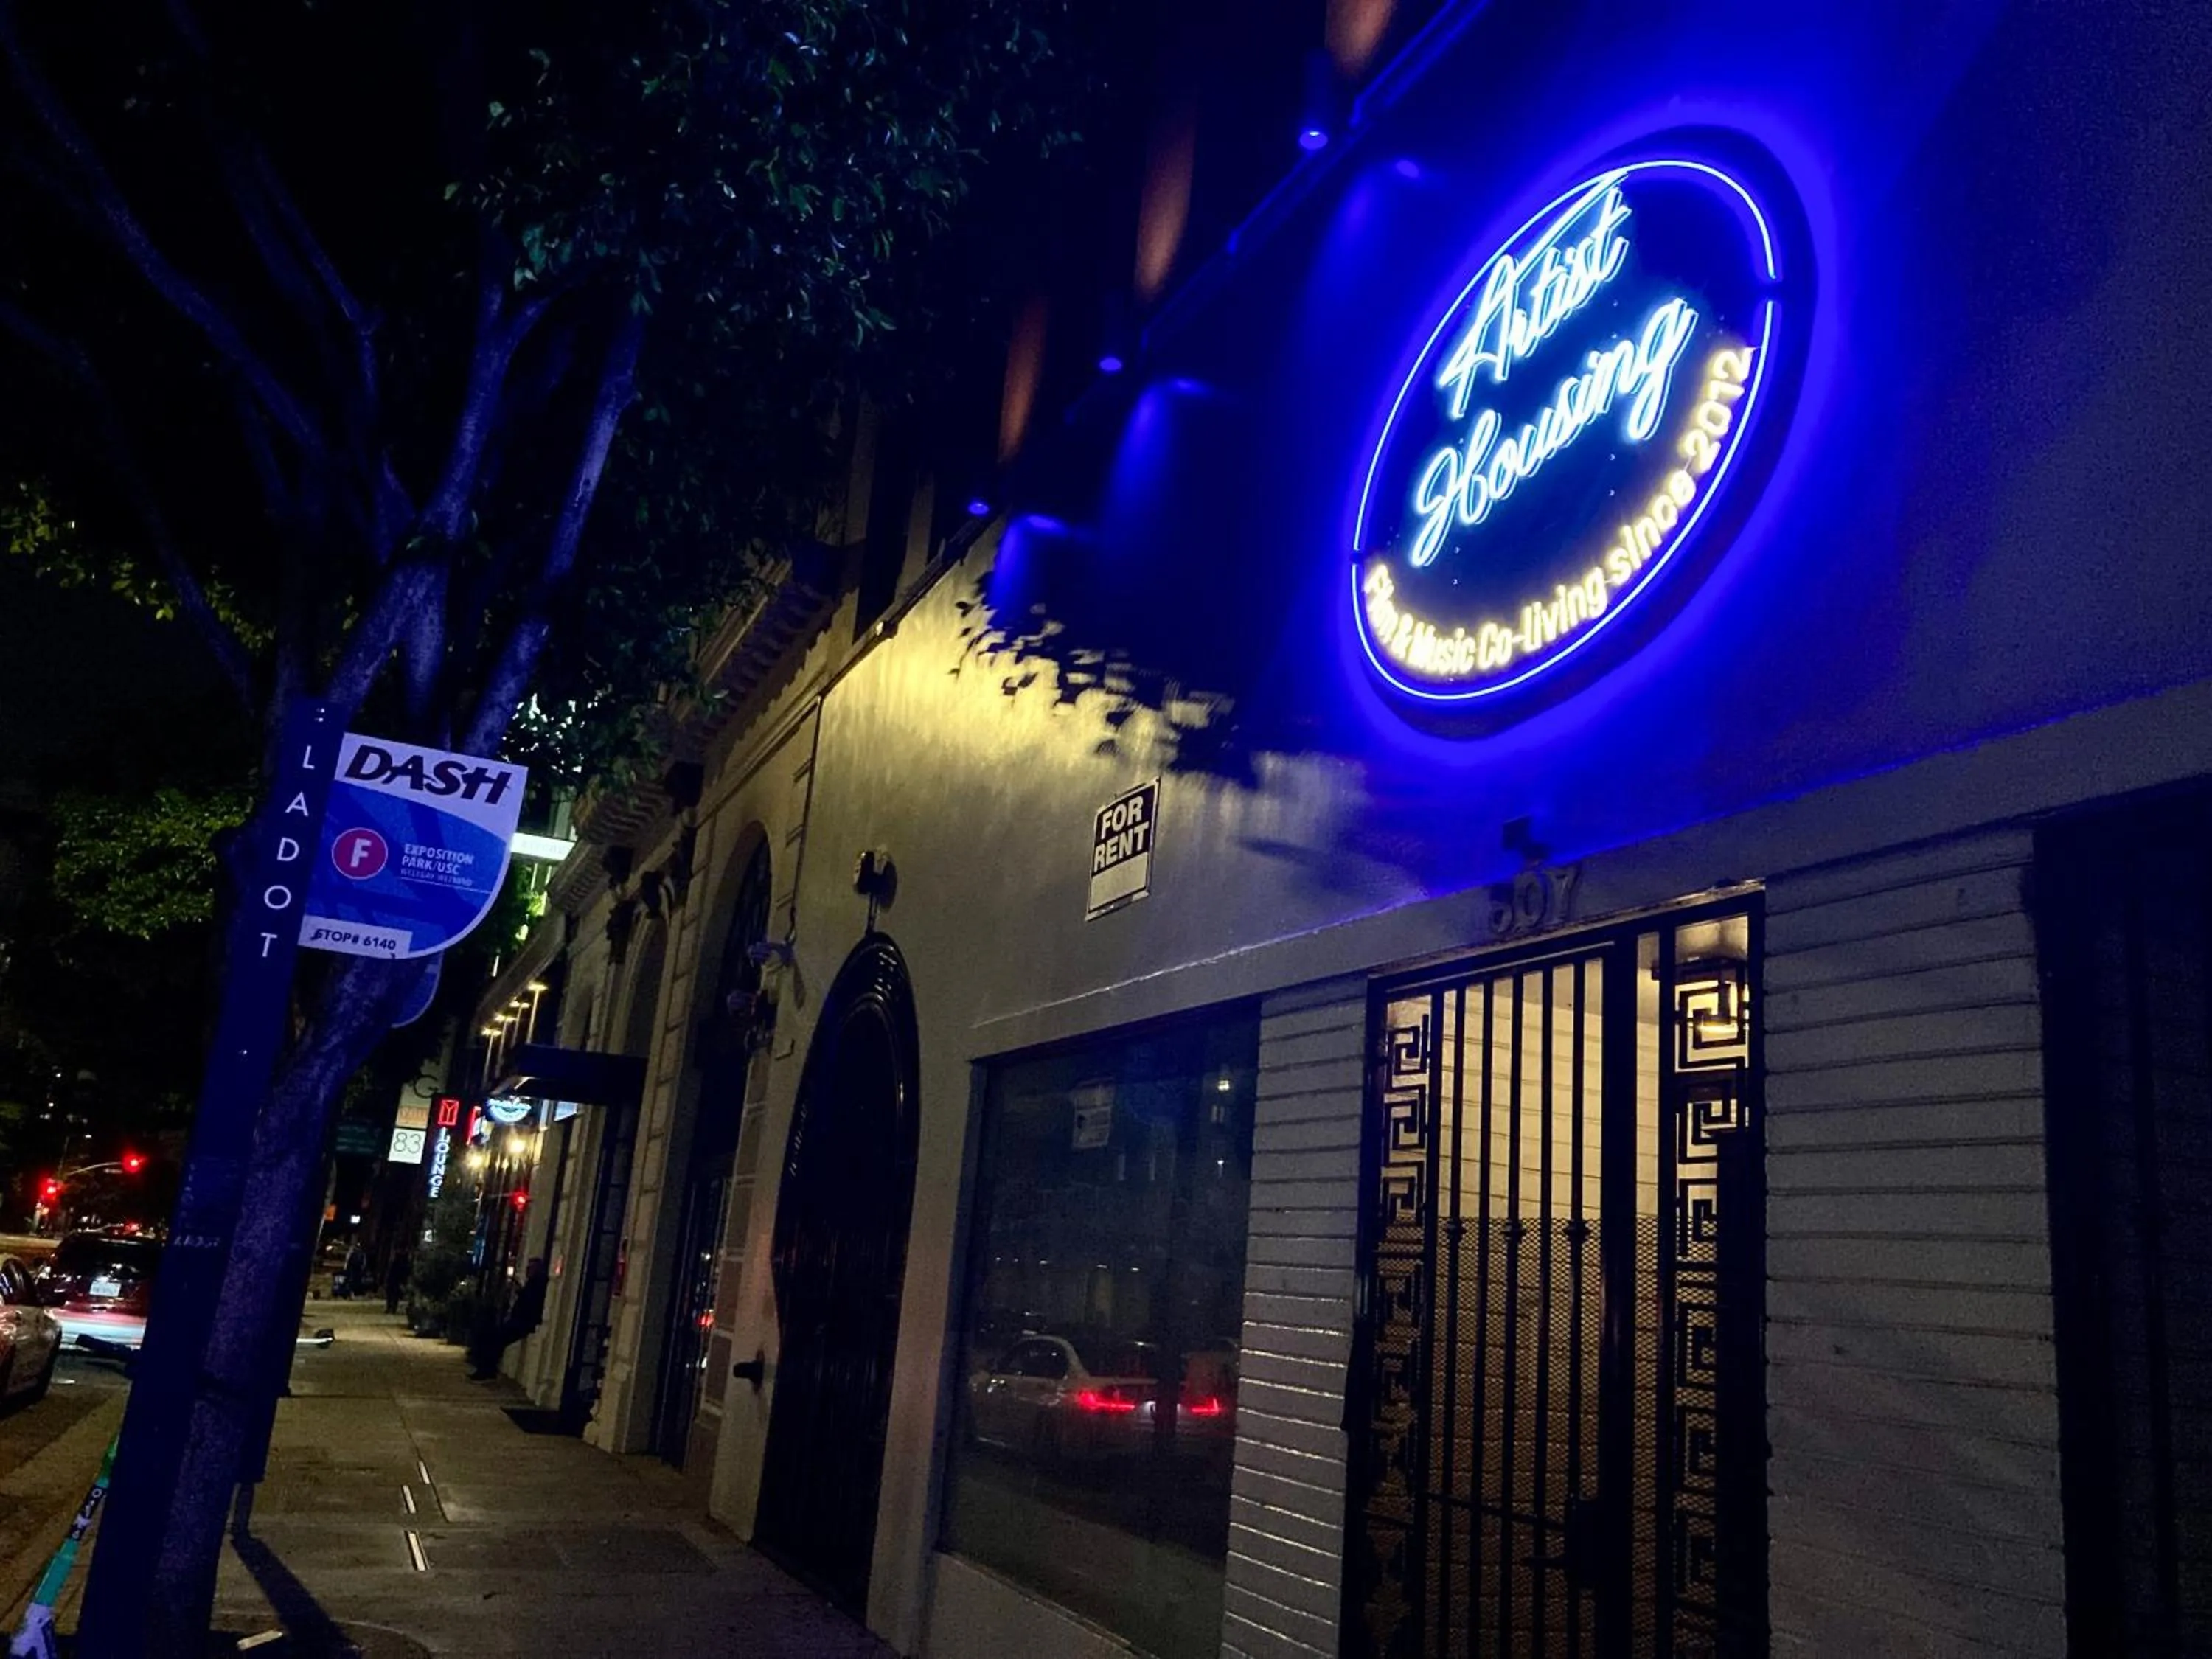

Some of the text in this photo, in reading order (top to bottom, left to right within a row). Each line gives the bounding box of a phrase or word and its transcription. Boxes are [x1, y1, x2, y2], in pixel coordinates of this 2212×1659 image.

[1436, 167, 1632, 419] Artist
[1411, 298, 1699, 567] Housing
[1406, 622, 1475, 675] Music
[1606, 470, 1697, 586] since
[1680, 348, 1753, 473] 2012
[344, 744, 512, 805] DASH
[1100, 796, 1144, 840] FOR
[350, 838, 372, 867] F
[401, 855, 461, 875] PARK/USC
[403, 843, 475, 865] EXPOSITION
[1093, 821, 1150, 873] RENT
[311, 928, 397, 950] STOP# 6140
[393, 1132, 422, 1154] 83
[428, 1127, 451, 1198] LOUNGE
